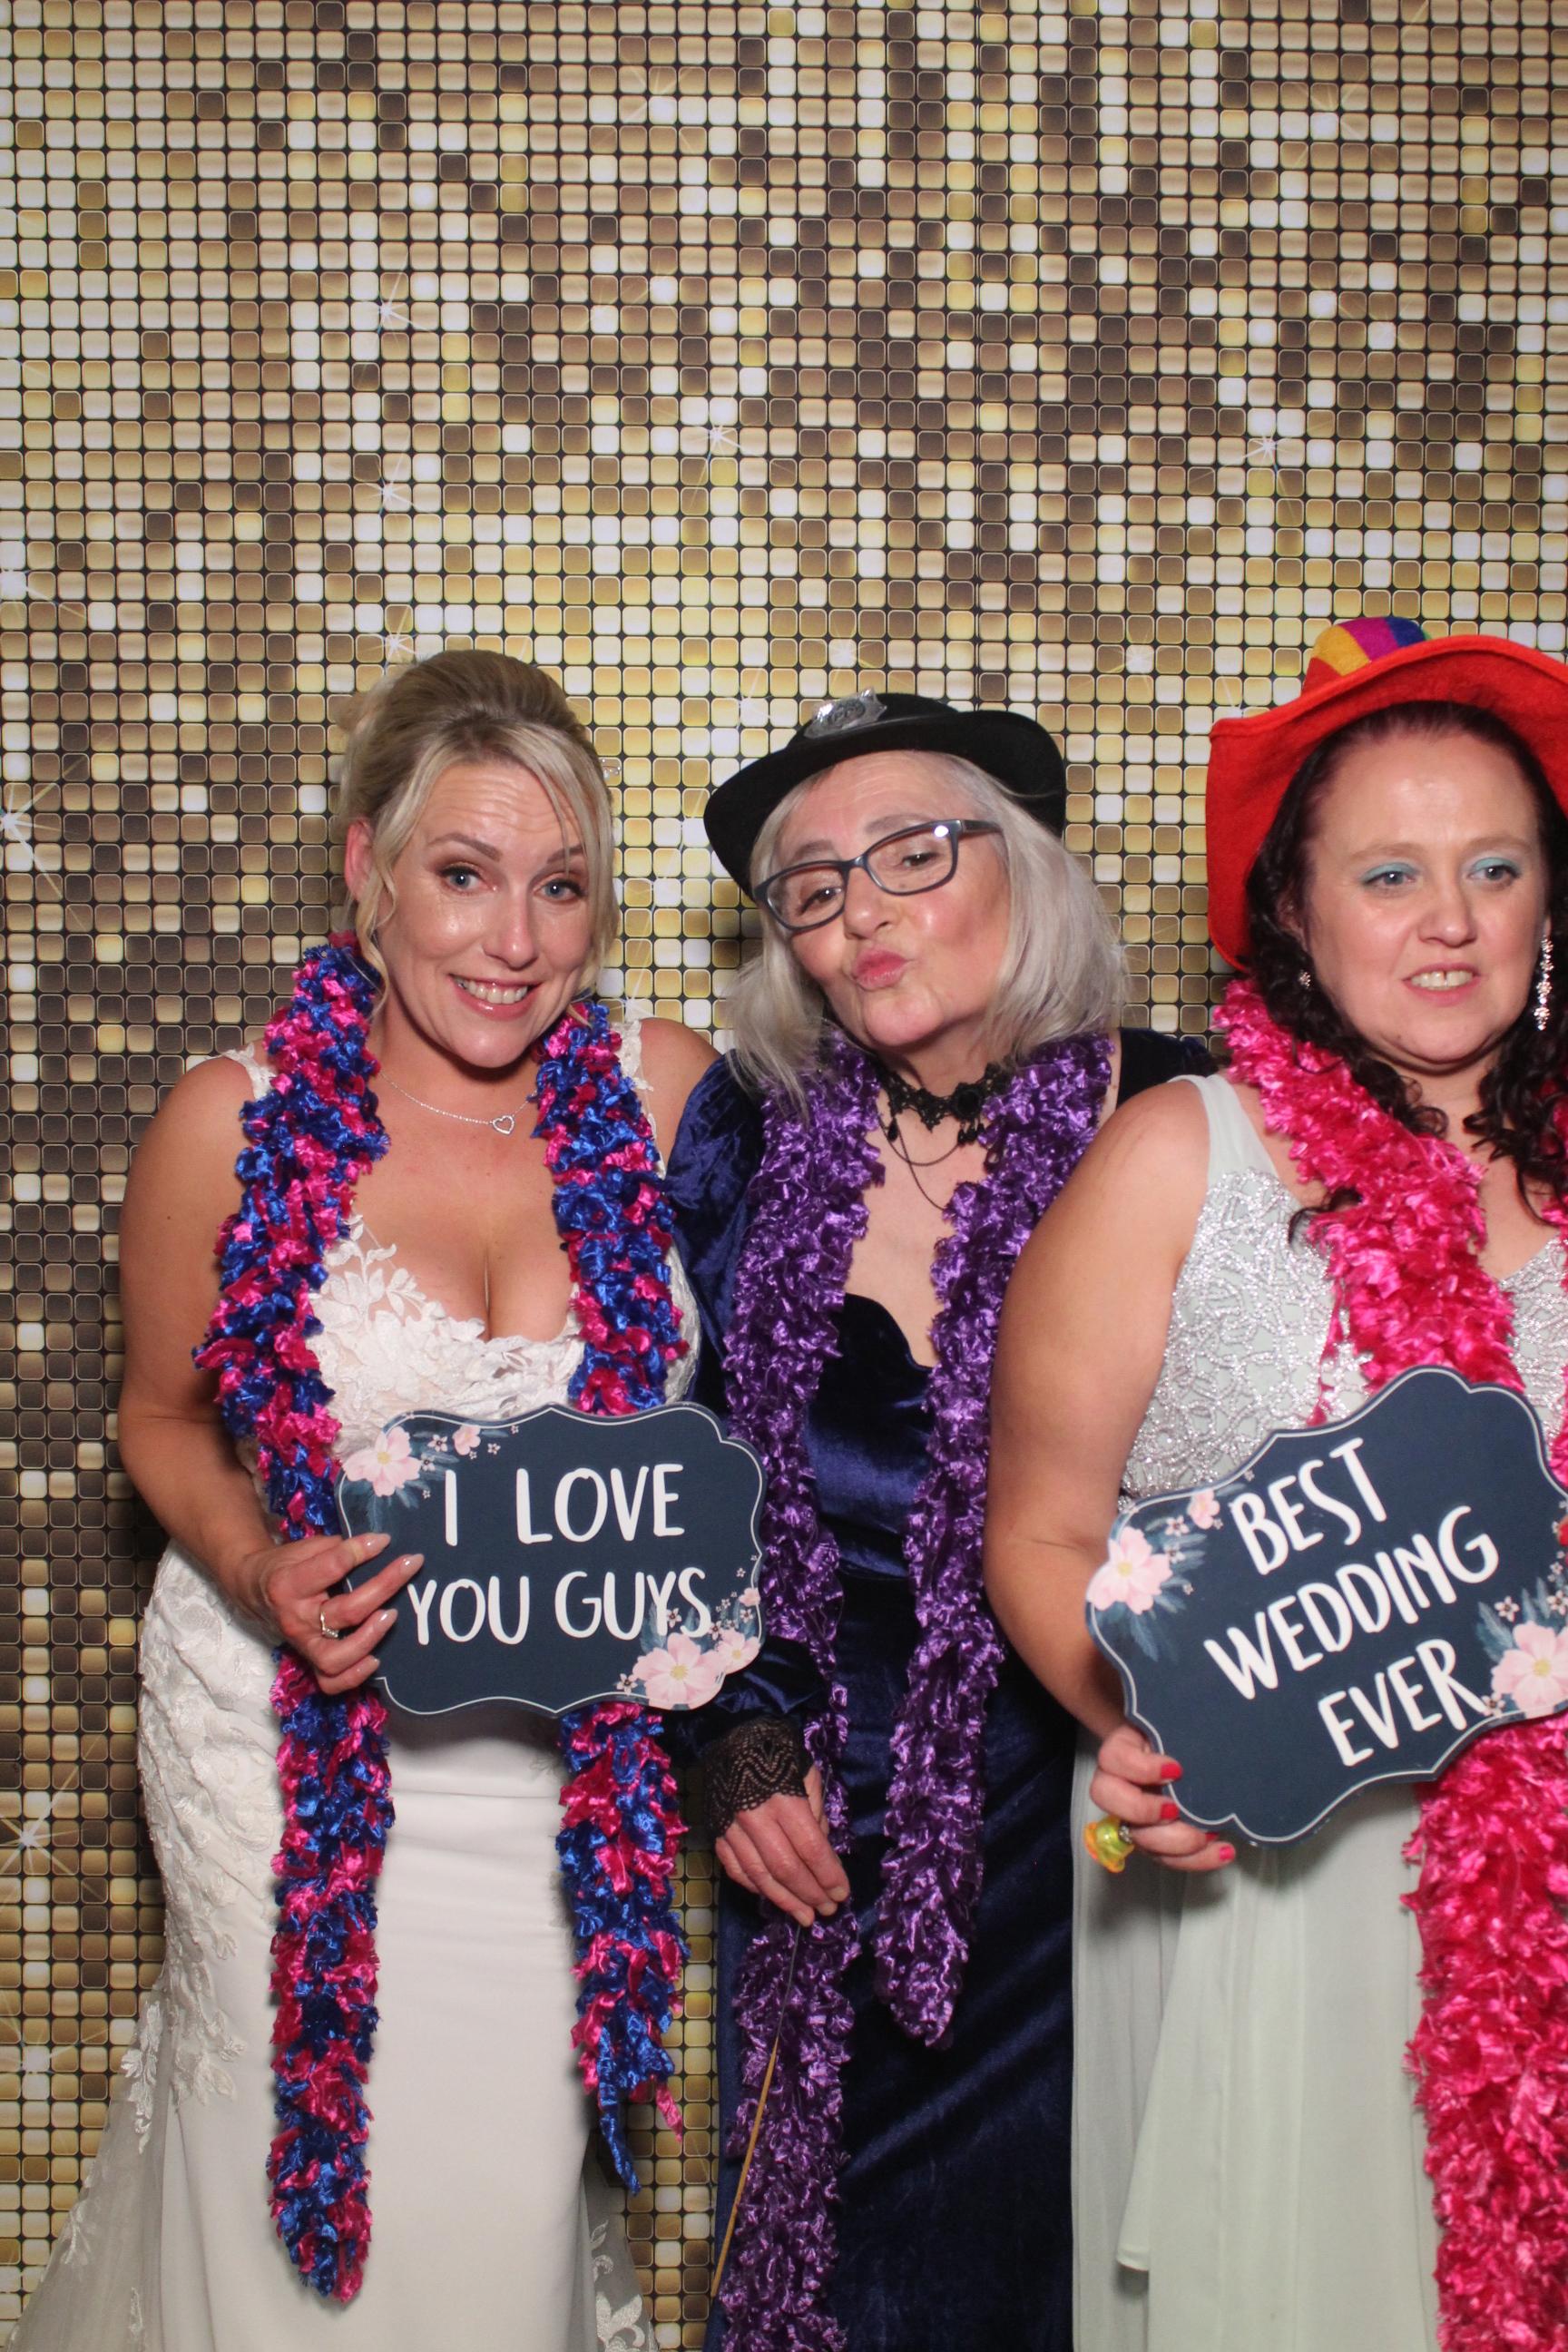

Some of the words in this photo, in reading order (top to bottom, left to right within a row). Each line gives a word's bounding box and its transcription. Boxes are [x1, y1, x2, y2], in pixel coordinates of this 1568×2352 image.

[445, 1469, 458, 1546] I
[516, 1464, 685, 1544] LOVE
[1229, 1437, 1387, 1575] BEST
[407, 1575, 530, 1646] YOU
[554, 1567, 712, 1642] GUYS
[1203, 1504, 1500, 1700] WEDDING
[1318, 1639, 1488, 1768] EVER
